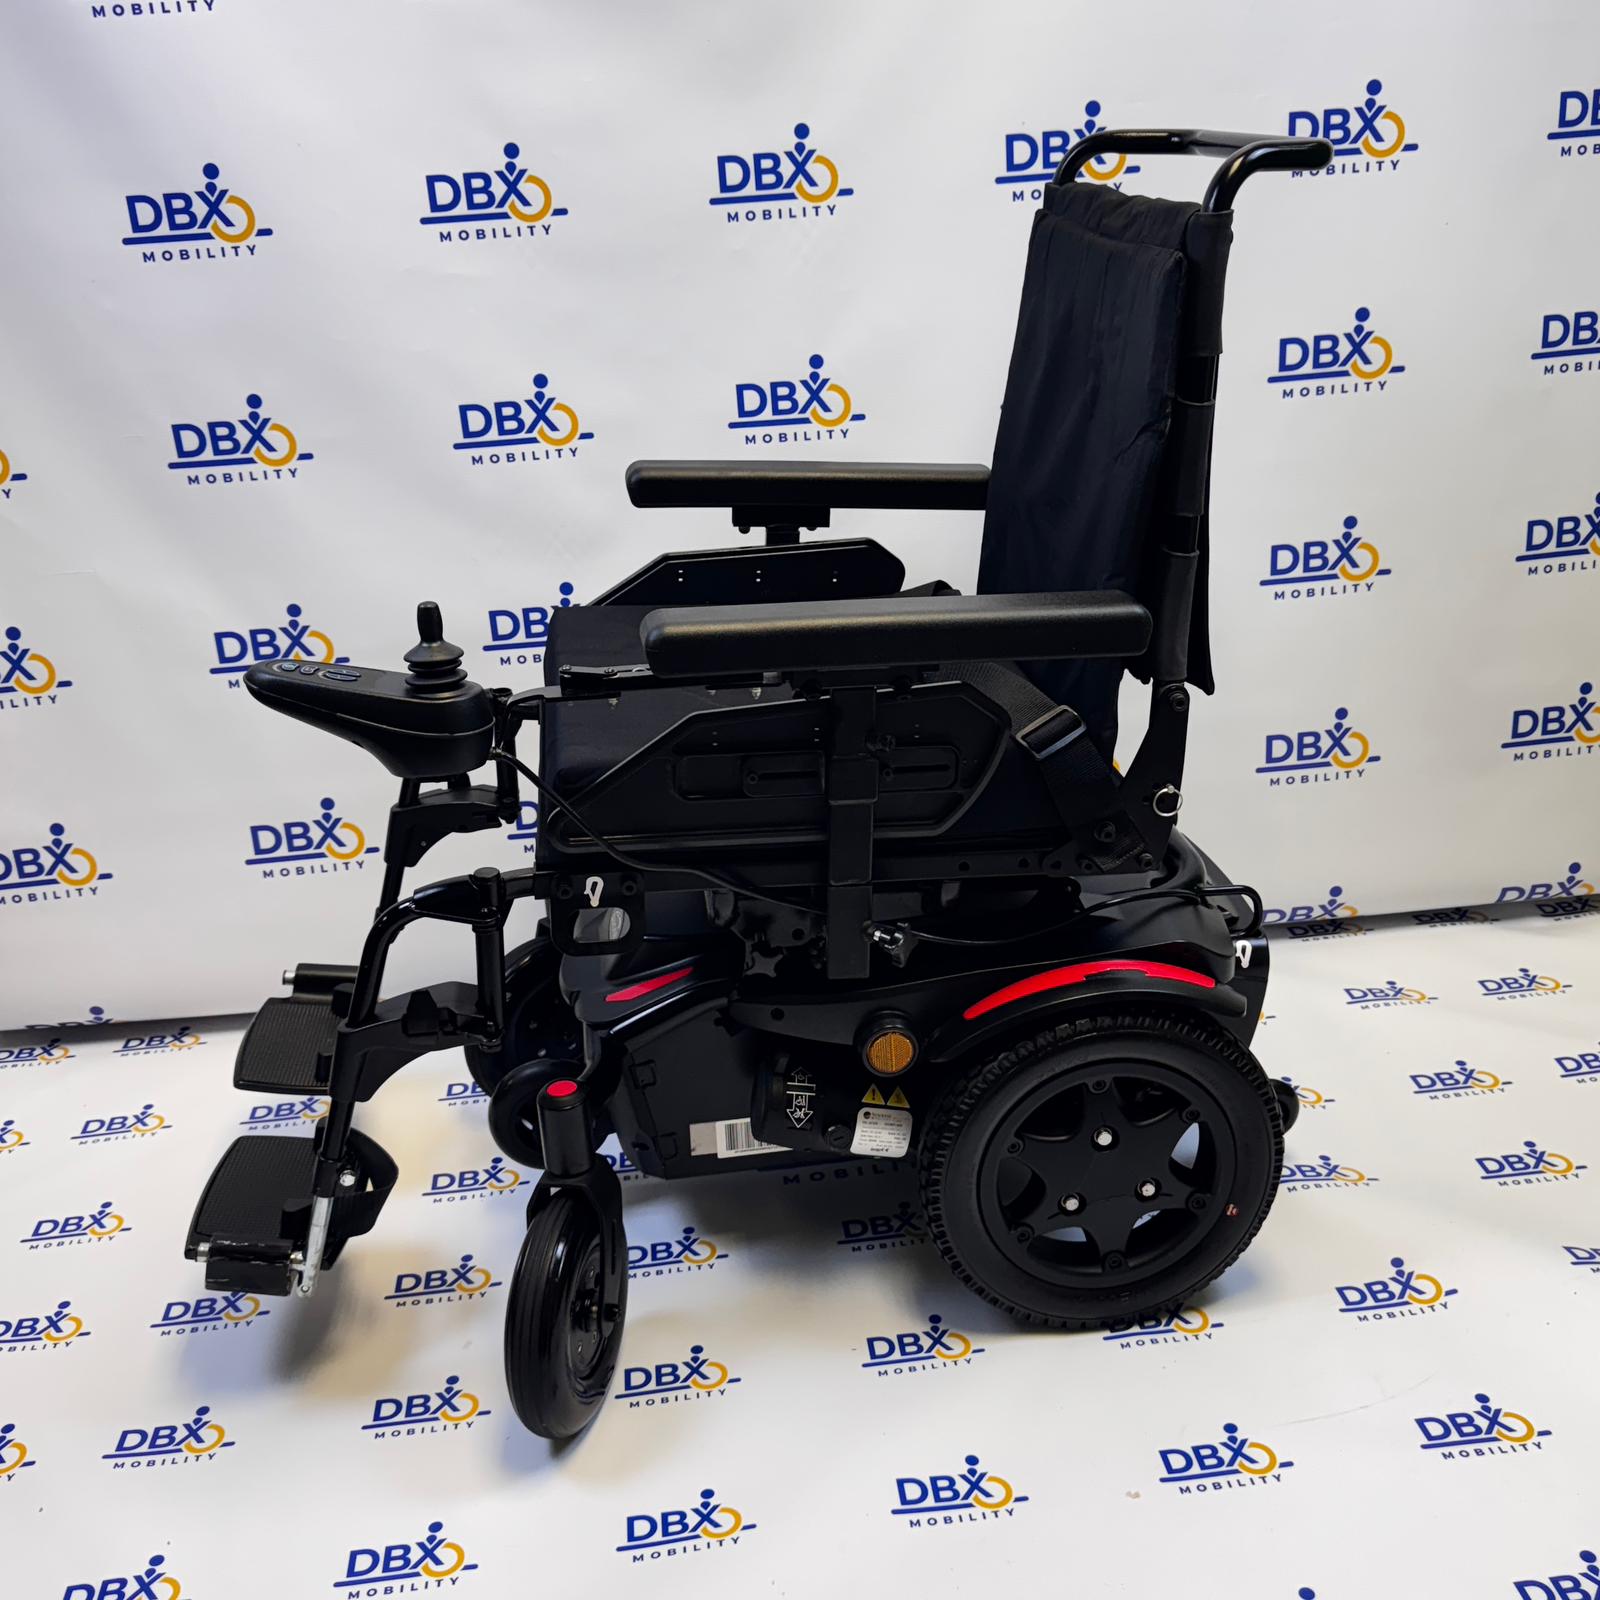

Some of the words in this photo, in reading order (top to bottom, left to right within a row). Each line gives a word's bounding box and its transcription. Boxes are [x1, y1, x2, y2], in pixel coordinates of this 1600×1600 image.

[92, 0, 216, 18] MOBILITY
[717, 149, 818, 194] DBX
[425, 168, 532, 213] DBX
[125, 189, 235, 233] DBX
[727, 204, 838, 223] MOBILITY
[439, 224, 552, 243] MOBILITY
[143, 244, 257, 263] MOBILITY
[1541, 311, 1600, 349] DB
[1279, 329, 1375, 372] DBX
[735, 377, 832, 419] DBX
[1282, 380, 1388, 399] MOBILITY
[458, 397, 560, 439] DBX
[171, 417, 278, 459] DBX
[744, 428, 850, 445] MOBILITY
[471, 447, 579, 465] MOBILITY
[187, 468, 298, 486] MOBILITY
[1270, 537, 1362, 576] DBX
[1528, 560, 1597, 577] MOBILI
[1274, 582, 1374, 600] MOBILITY
[488, 607, 549, 641] DB
[213, 625, 316, 665] DBX
[1511, 702, 1597, 739] DBX
[1265, 727, 1353, 764] DBX
[1513, 745, 1600, 761] MOBILIT
[1270, 769, 1365, 786] MOBILITY
[250, 817, 347, 856] DBX
[262, 860, 365, 879] MOBILITY
[1343, 985, 1415, 1000] DBX
[1478, 973, 1546, 993] DBX
[122, 1032, 190, 1049] DBX
[1554, 1051, 1600, 1074] DB
[1410, 1065, 1485, 1090] DBX
[1429, 1086, 1506, 1101] MOBILITY
[249, 1098, 320, 1120] DBX
[80, 1113, 152, 1135] DBX
[1476, 1151, 1555, 1175] DBX
[431, 1164, 509, 1191] DBX
[1287, 1180, 1372, 1194] MOBILITY
[1498, 1171, 1581, 1188] MOBILITY
[432, 1188, 516, 1204] MOBILITY
[31, 1211, 112, 1237] DBX
[841, 1211, 921, 1239] DBX
[29, 1234, 116, 1250] MOBILITY
[394, 1262, 477, 1293] DBX
[1334, 1271, 1426, 1306] DBX
[161, 1288, 248, 1323] DBX
[396, 1289, 488, 1307] MOBILITY
[1357, 1300, 1450, 1322] MOBILITY
[160, 1319, 254, 1337] MOBILITY
[866, 1328, 954, 1360] DBX
[1120, 1331, 1214, 1351] MOBILITY
[623, 1357, 712, 1391] DBX
[877, 1357, 972, 1377] MOBILITY
[371, 1388, 465, 1422] DBX
[629, 1388, 726, 1408] MOBILITY
[113, 1417, 207, 1452] DBX
[374, 1420, 475, 1439] MOBILITY
[1414, 1408, 1516, 1443] DBX
[113, 1452, 216, 1470] MOBILITY
[1158, 1437, 1259, 1475] DBX
[1441, 1441, 1543, 1460] MOBILITY
[895, 1471, 994, 1506] DBX
[1179, 1474, 1283, 1495] MOBILITY
[626, 1502, 721, 1543] DBX
[909, 1507, 1015, 1528] MOBILITY
[345, 1537, 444, 1578] DBX
[632, 1536, 740, 1563] MOBILITY
[347, 1576, 460, 1599] MOBILITY
